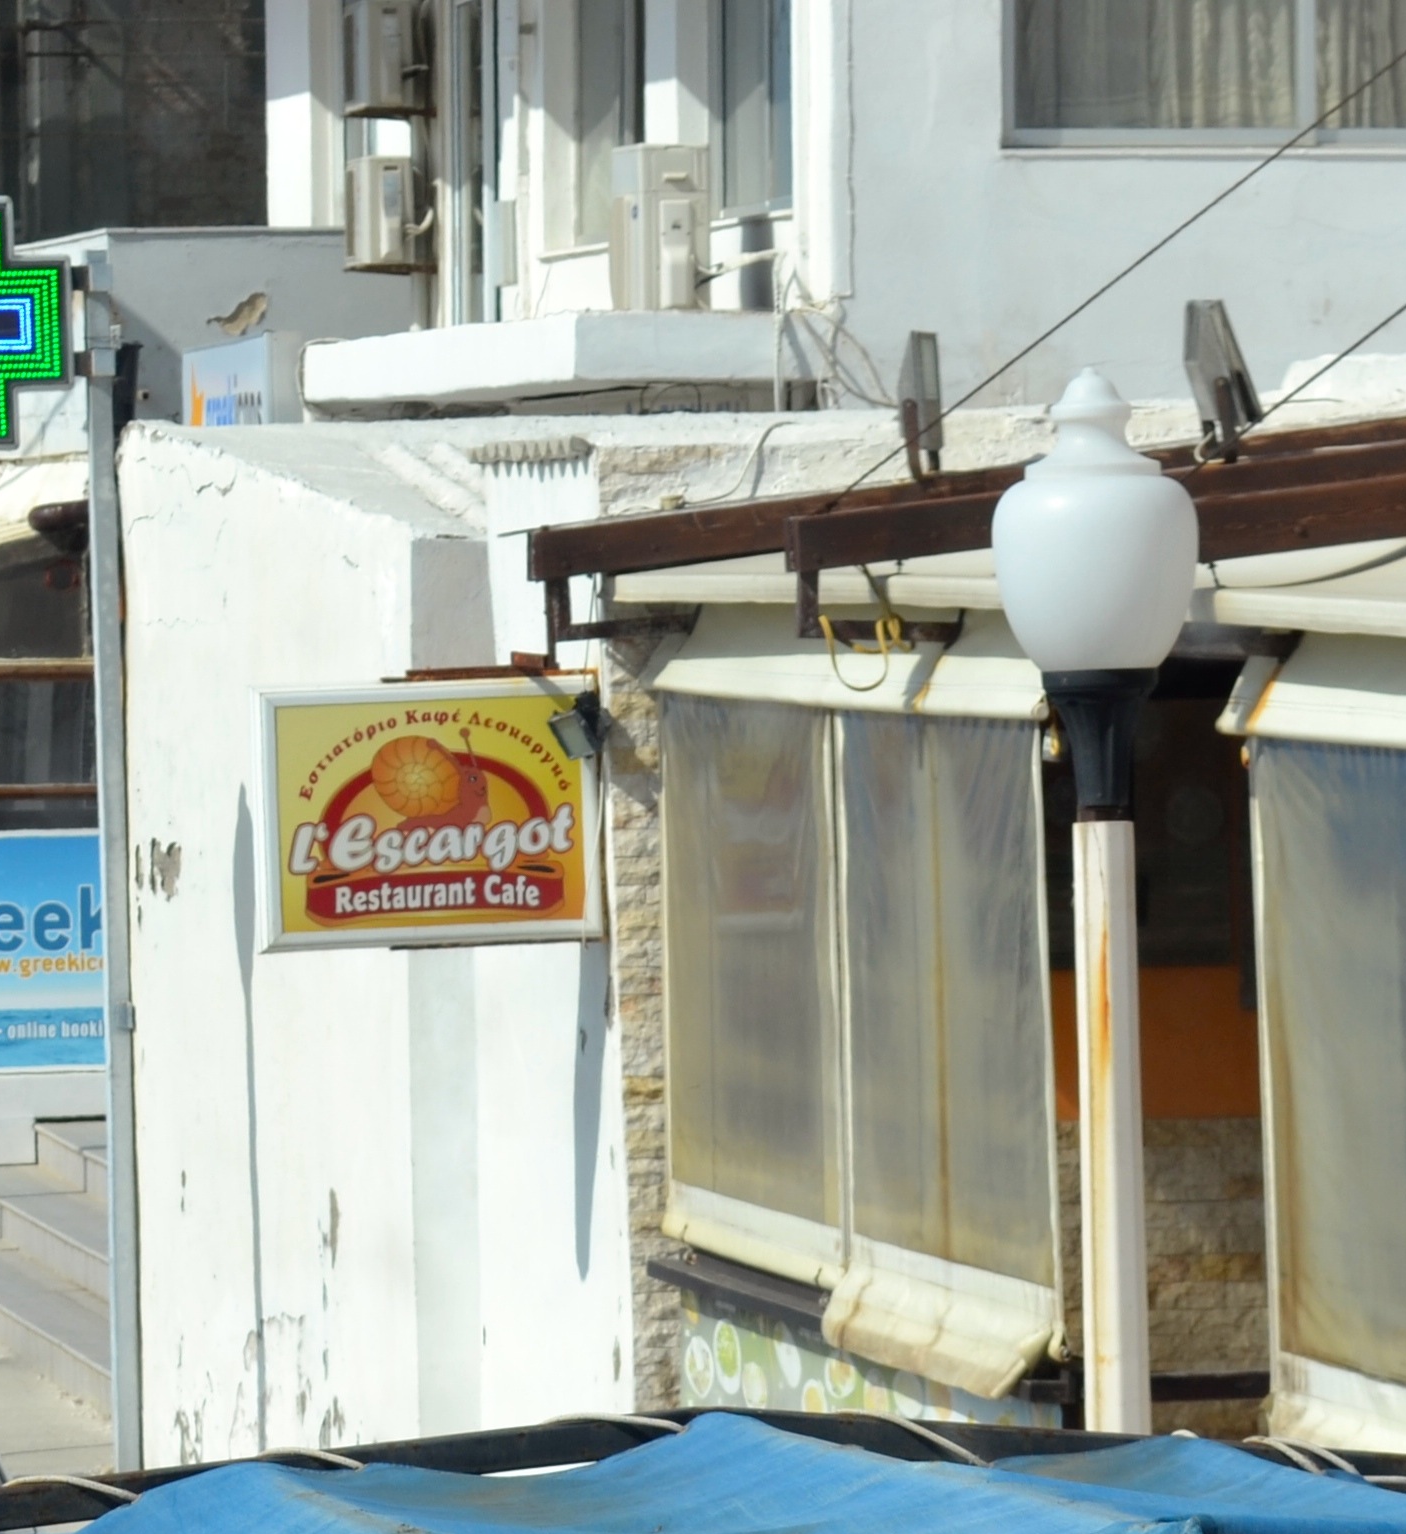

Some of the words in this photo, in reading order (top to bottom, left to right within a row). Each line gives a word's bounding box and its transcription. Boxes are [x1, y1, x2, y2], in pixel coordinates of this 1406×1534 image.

[404, 708, 461, 725] Καφέ
[334, 878, 476, 914] Restaurant
[483, 875, 541, 907] Cafe
[6, 1021, 57, 1040] online
